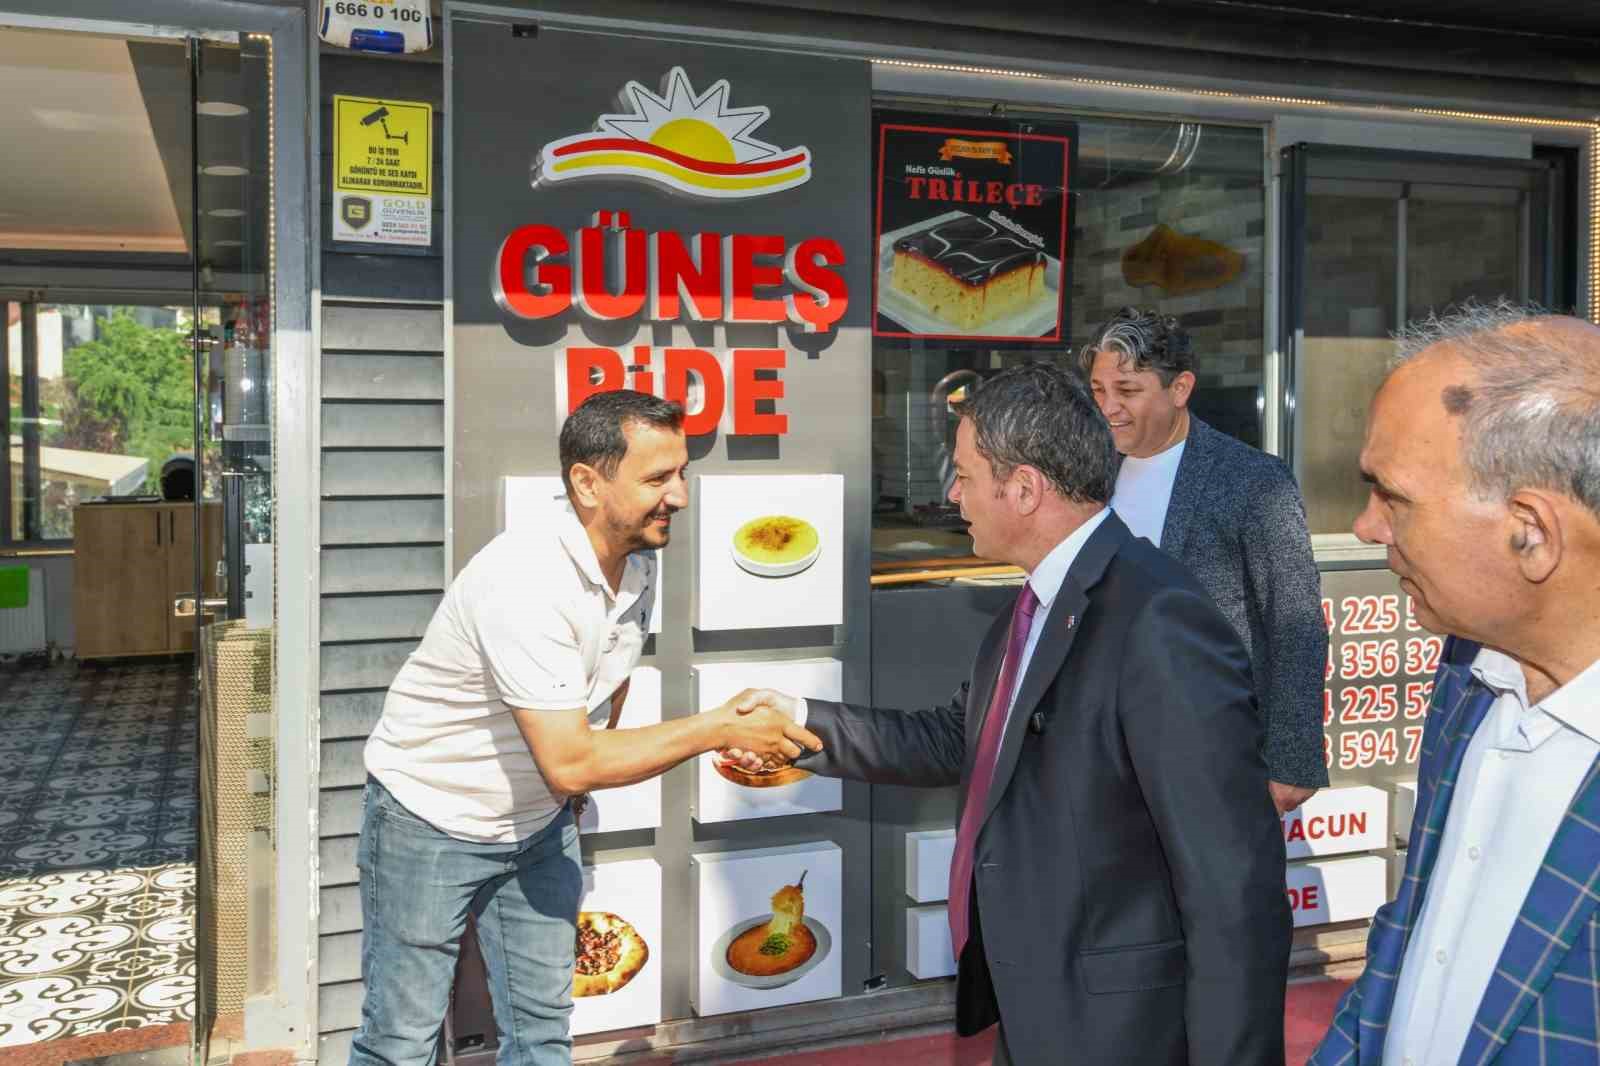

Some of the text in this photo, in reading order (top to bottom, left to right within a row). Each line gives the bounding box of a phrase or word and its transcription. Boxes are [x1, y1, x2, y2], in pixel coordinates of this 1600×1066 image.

[335, 2, 367, 17] 666
[374, 6, 383, 18] 0
[383, 199, 426, 208] GOLD
[906, 172, 1043, 209] TRİLEÇE
[494, 210, 848, 332] GÜNEŞ
[1341, 595, 1400, 634] 225
[1341, 639, 1399, 679] 356
[1405, 637, 1442, 675] 32
[1340, 685, 1398, 723] 225
[1340, 728, 1398, 768] 594
